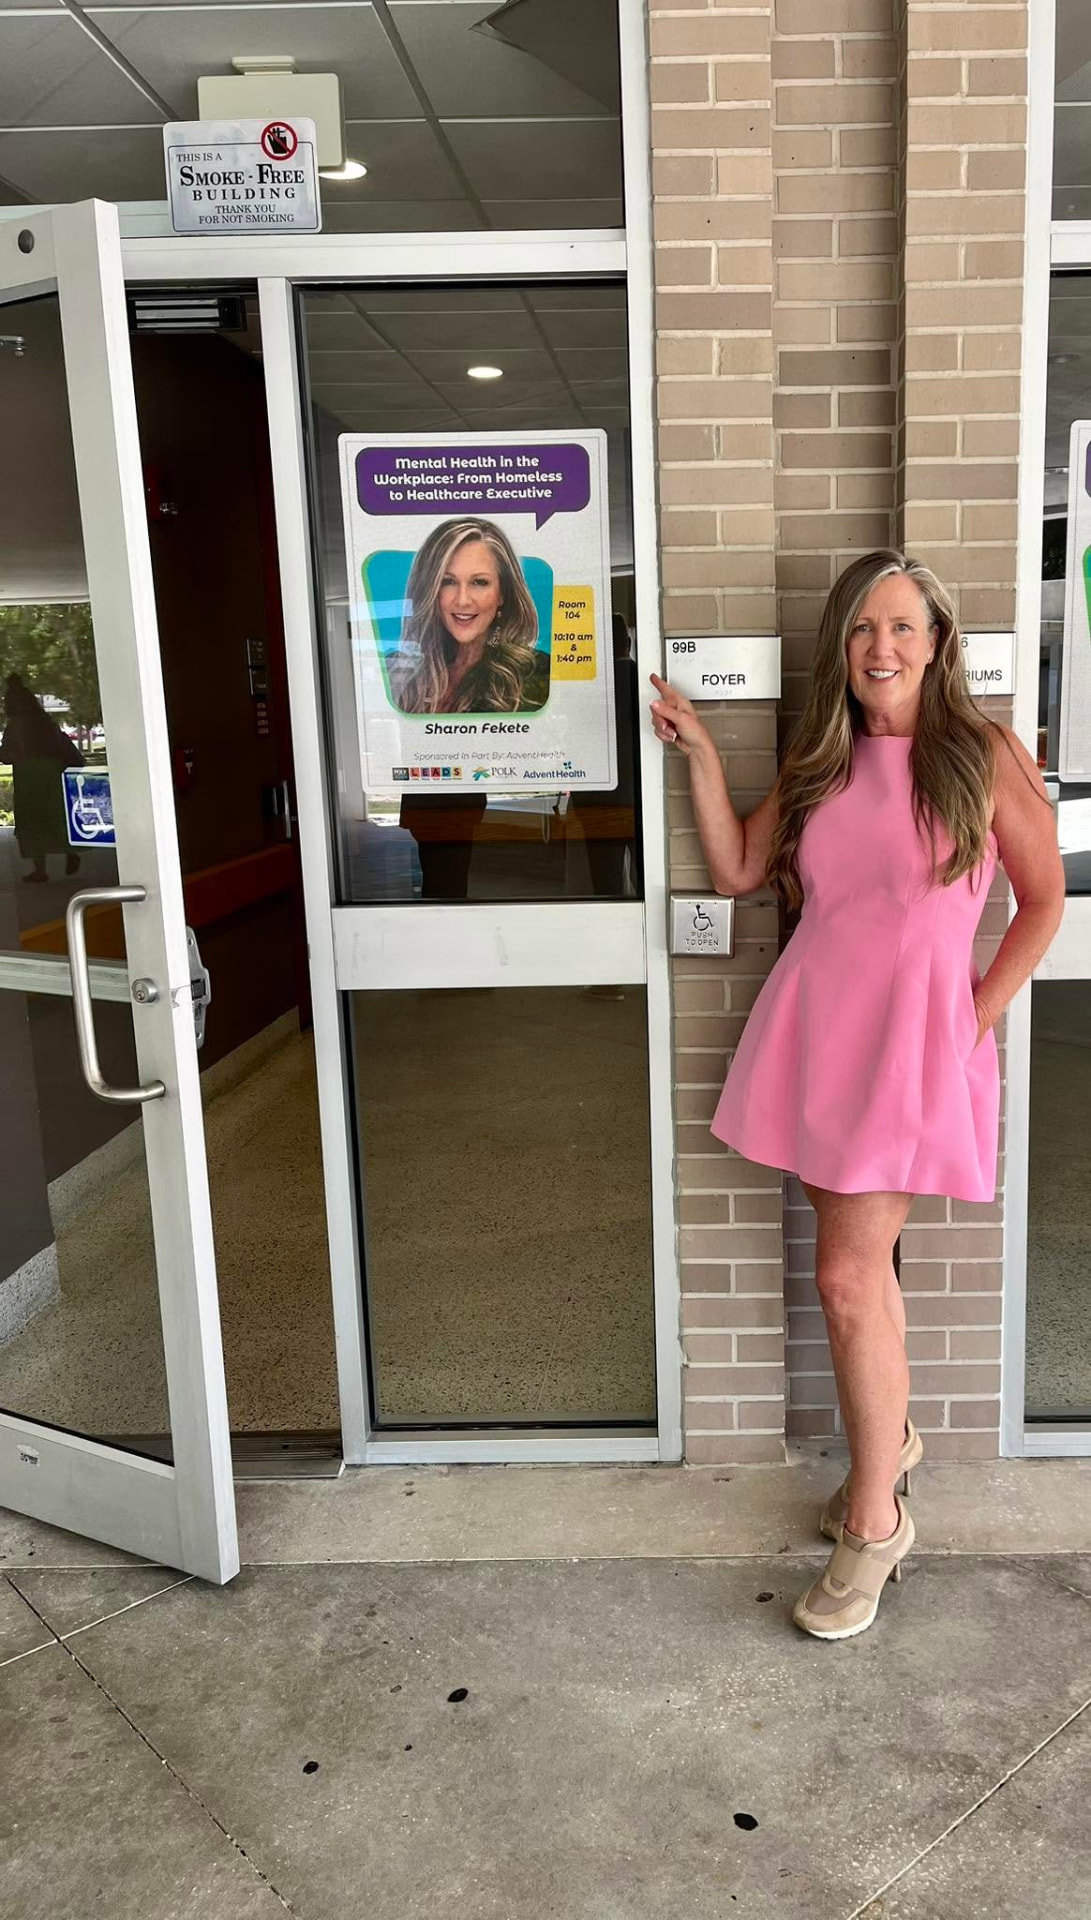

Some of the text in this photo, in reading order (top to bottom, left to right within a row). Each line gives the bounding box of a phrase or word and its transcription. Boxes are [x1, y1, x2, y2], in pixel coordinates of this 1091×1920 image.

[176, 153, 223, 162] THIS IS A
[179, 165, 245, 187] SMOKE
[256, 163, 305, 184] FREE
[192, 187, 296, 201] BUILDING
[215, 204, 276, 214] THANK YOU
[199, 214, 295, 224] FOR NOT SMOKING
[395, 455, 540, 469] Mental Health in the
[373, 471, 563, 487] Workplace: From Homeless
[389, 486, 552, 500] to Healthcare Executive
[558, 600, 586, 608] Room
[565, 611, 580, 619] 104
[554, 633, 575, 641] 10:10
[961, 636, 969, 648] 6
[570, 643, 577, 651] &
[672, 641, 696, 653] 99B
[556, 654, 592, 664] 1:40 pm
[702, 674, 746, 685] FOYER
[964, 669, 1003, 681] RIUMS
[424, 722, 530, 734] Sharon Fekete
[414, 752, 459, 761] Sponsored
[461, 752, 469, 760] In
[471, 752, 490, 760] Part
[506, 750, 565, 760] AdventHealth
[411, 767, 460, 777] LEADS
[491, 767, 517, 776] POLK
[523, 769, 586, 779] AdventHealth
[685, 938, 696, 946] TO
